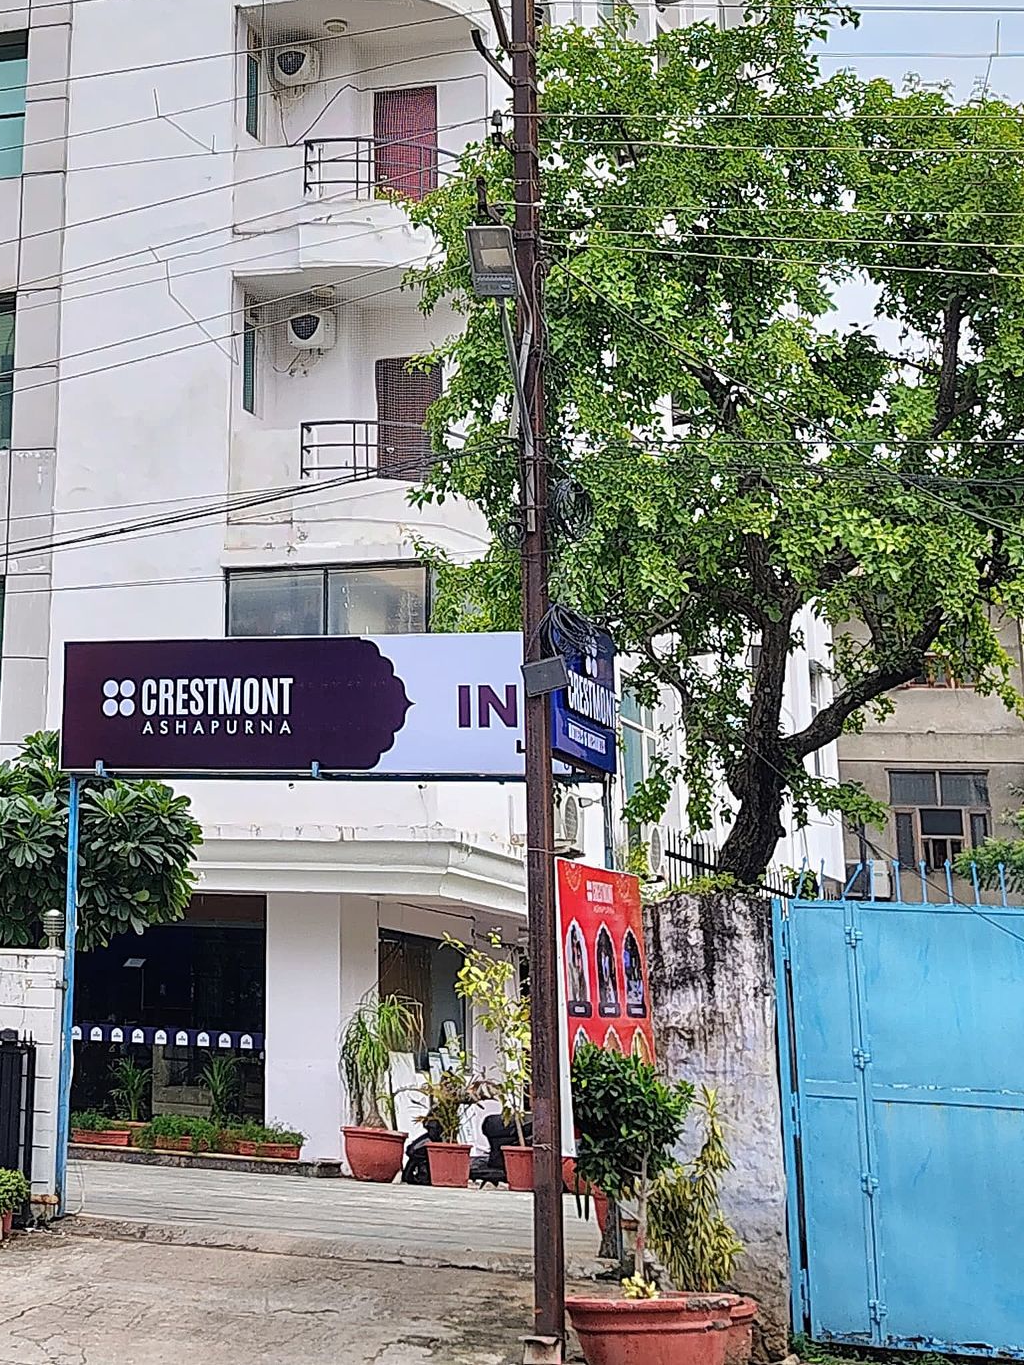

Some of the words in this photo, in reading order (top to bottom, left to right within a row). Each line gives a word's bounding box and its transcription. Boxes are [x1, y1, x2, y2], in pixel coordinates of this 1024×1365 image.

[141, 677, 294, 716] CRESTMONT
[458, 684, 518, 728] IN
[567, 669, 616, 729] CRESTMONT
[142, 720, 292, 735] ASHAPURNA
